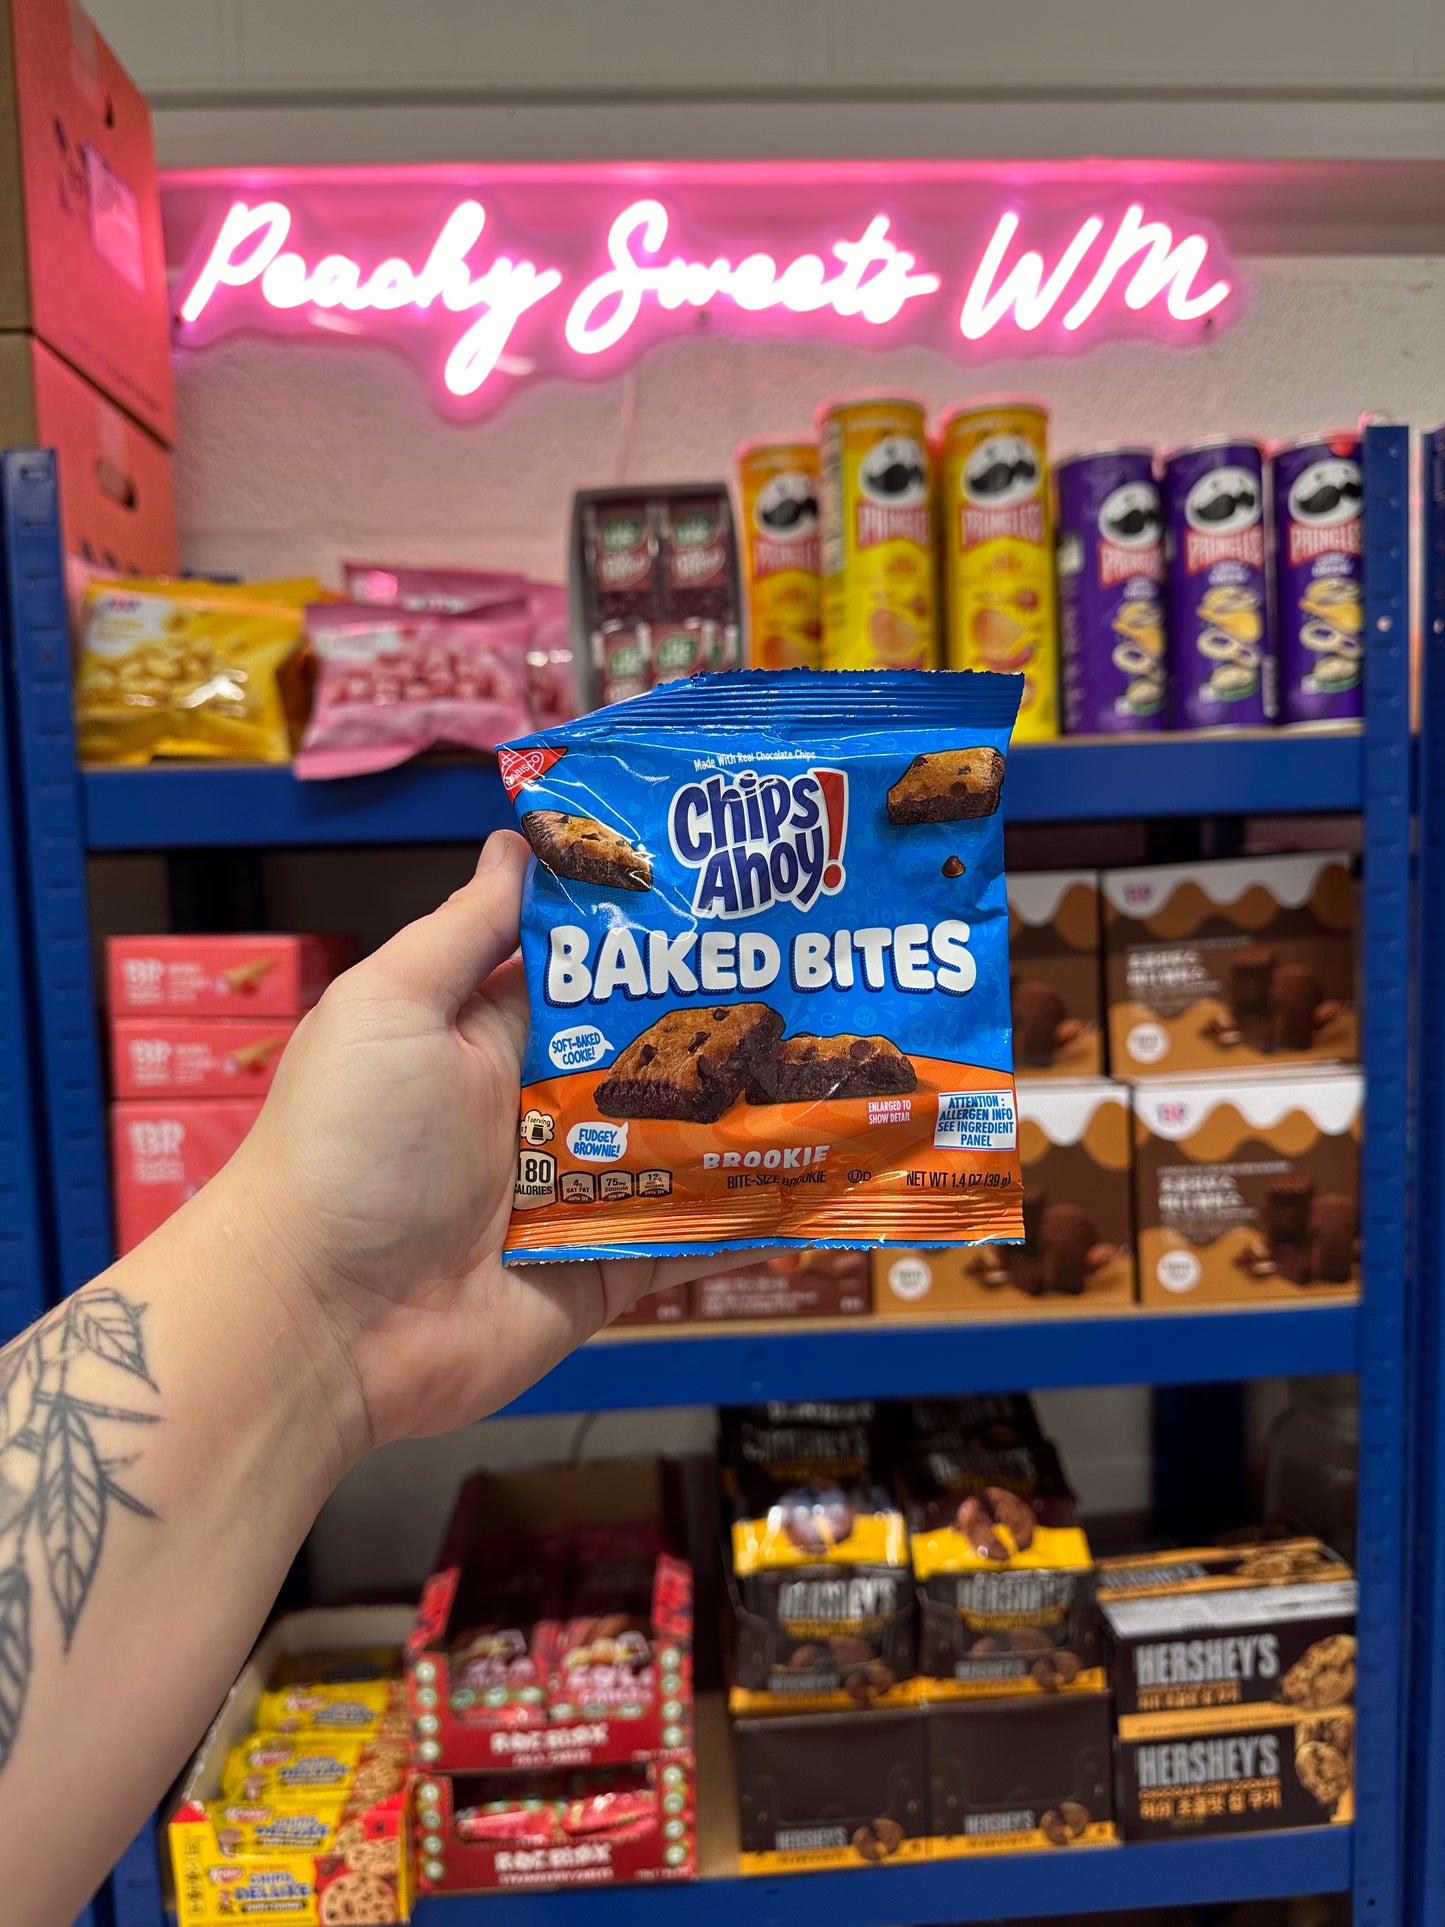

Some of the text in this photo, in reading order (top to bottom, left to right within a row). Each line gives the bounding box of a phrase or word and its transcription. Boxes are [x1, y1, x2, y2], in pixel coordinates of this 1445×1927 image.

[180, 199, 563, 396] Peachy
[565, 199, 940, 353] Sweets
[694, 750, 816, 772] Made With Real Chocolate Chips
[674, 773, 820, 862] Chips
[546, 919, 977, 1006] BAKED BITES
[552, 1032, 600, 1054] SOFT-BAKED
[562, 1046, 596, 1065] COOKIE!
[868, 1100, 912, 1113] ENLARGED TO
[948, 1095, 999, 1110] ATTENTION
[869, 1112, 911, 1125] SHOW DETAIL
[939, 1108, 1013, 1121] ALLERGEN INFO
[578, 1128, 618, 1144] FUDGEY
[937, 1121, 1014, 1134] SEE INGREDIENT
[573, 1142, 620, 1158] BROWNIE!
[960, 1134, 992, 1147] PANEL
[703, 1145, 830, 1170] BROOKIE
[517, 1158, 552, 1184] 180
[727, 1170, 827, 1190] BITE-SIZE BROOKIE
[906, 1170, 928, 1186] NET
[929, 1172, 949, 1188] WT
[951, 1172, 966, 1188] 1.4
[968, 1173, 982, 1186] OZ
[984, 1172, 1000, 1188] (39
[1135, 1633, 1280, 1687] HERSHEY'S
[1137, 1733, 1280, 1788] HERSHEY'S
